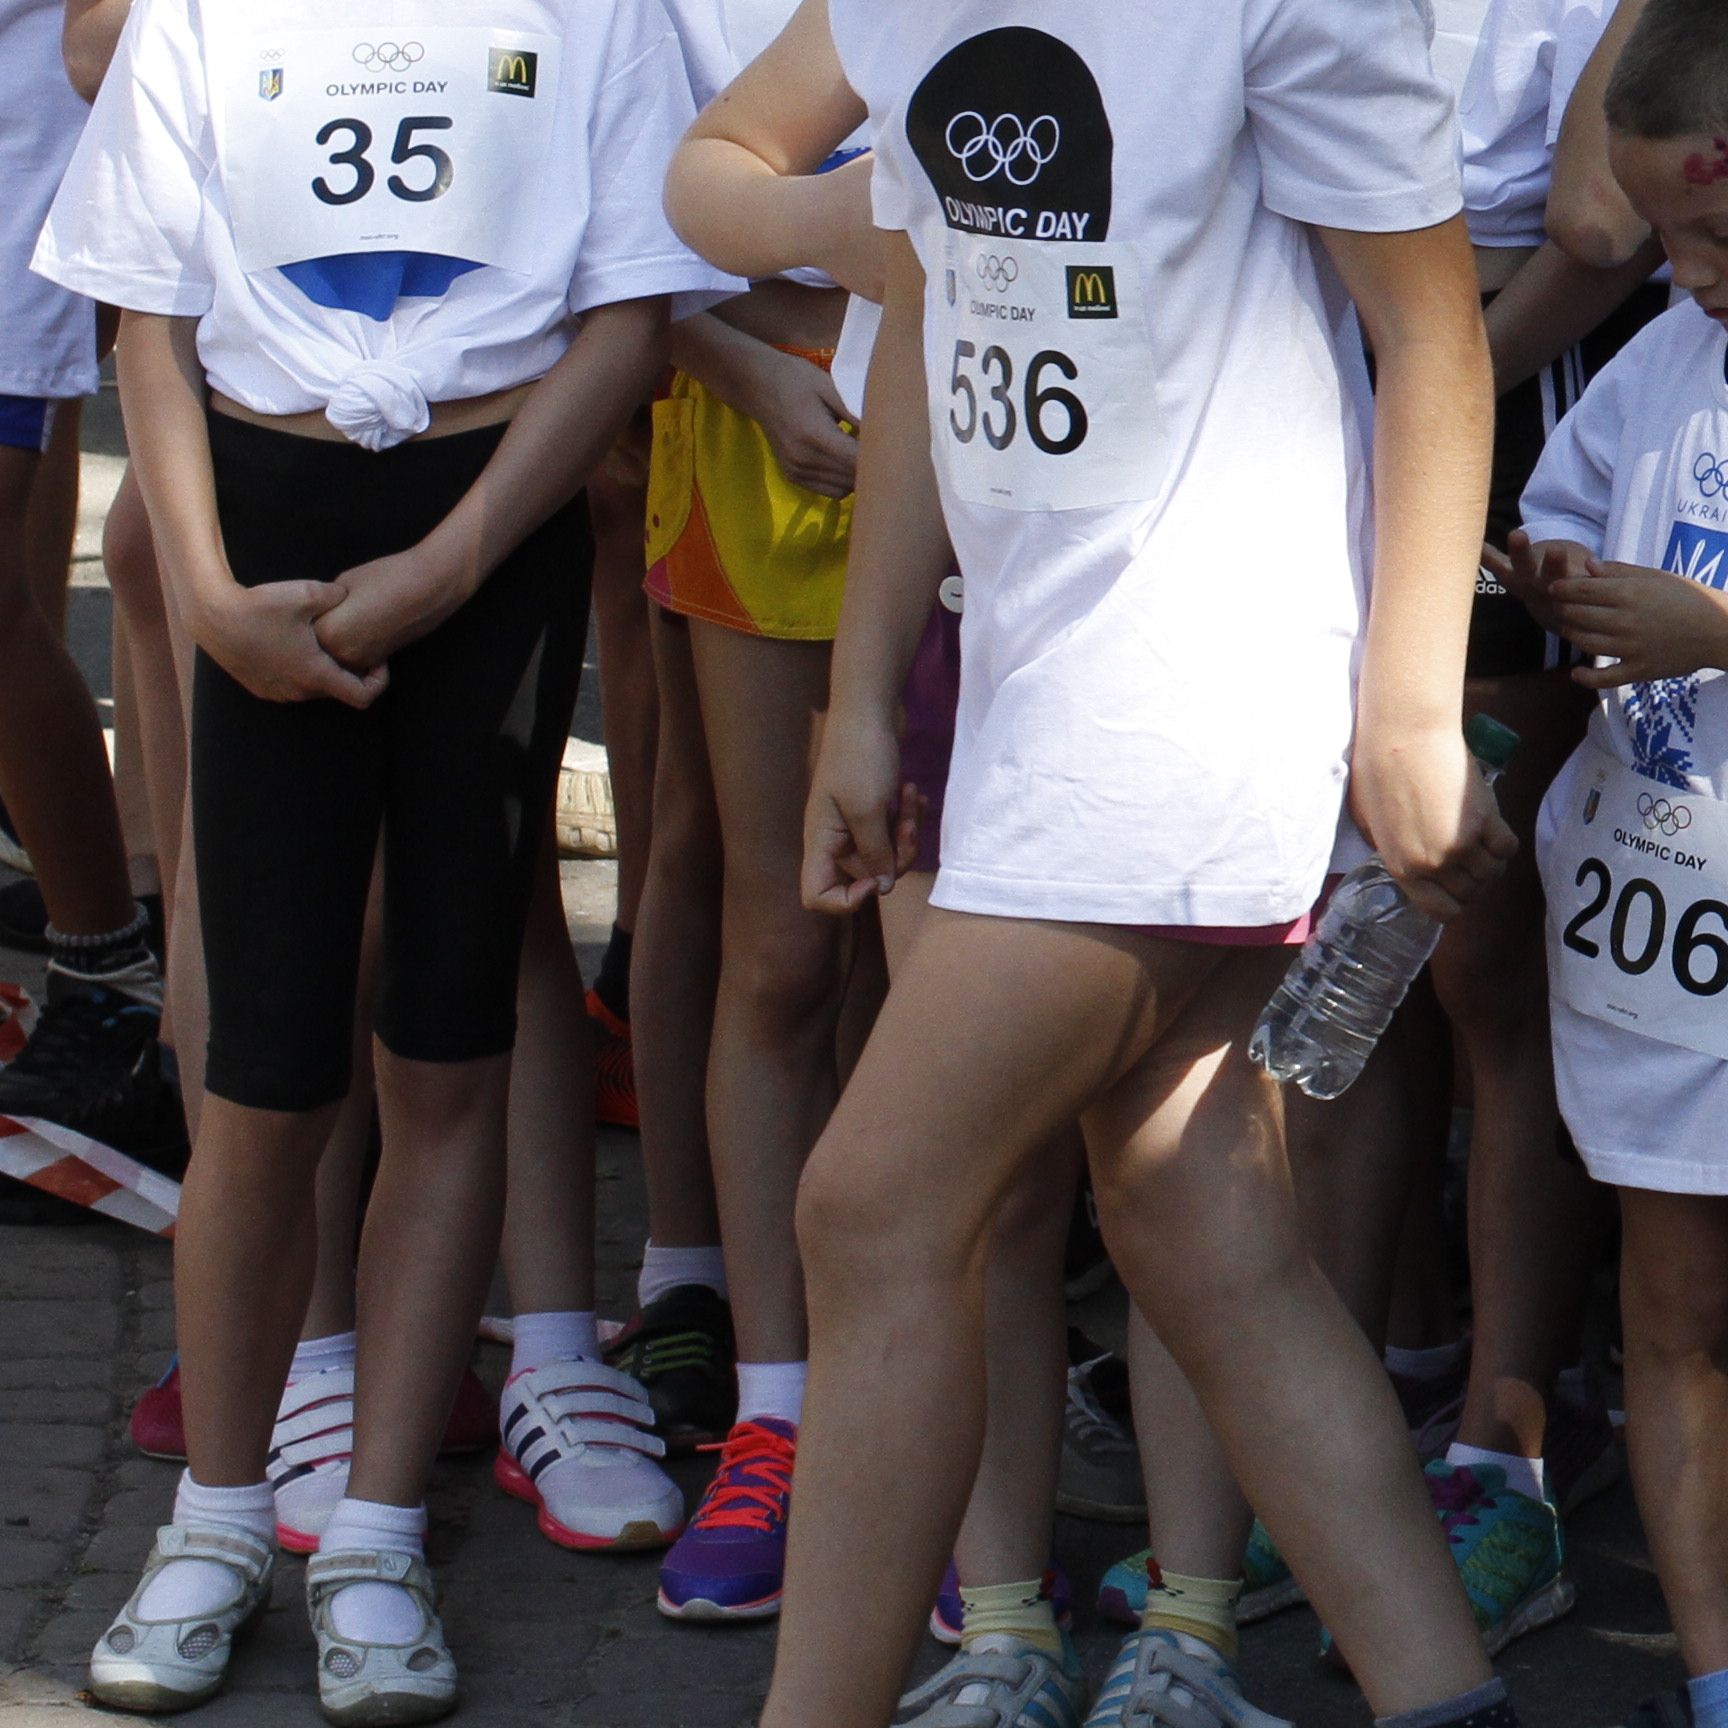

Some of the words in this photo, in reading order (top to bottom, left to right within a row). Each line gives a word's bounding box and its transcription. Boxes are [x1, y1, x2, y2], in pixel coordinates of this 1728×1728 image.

[326, 81, 407, 97] OLYMPIC
[413, 80, 449, 94] DAY
[311, 115, 455, 206] 35
[945, 196, 1028, 236] OLYMPIC
[1035, 211, 1090, 240] DAY
[1010, 306, 1036, 322] DAY
[950, 338, 1089, 456] 536
[1613, 828, 1671, 861] OLYMPIC
[1674, 850, 1707, 872] DAY
